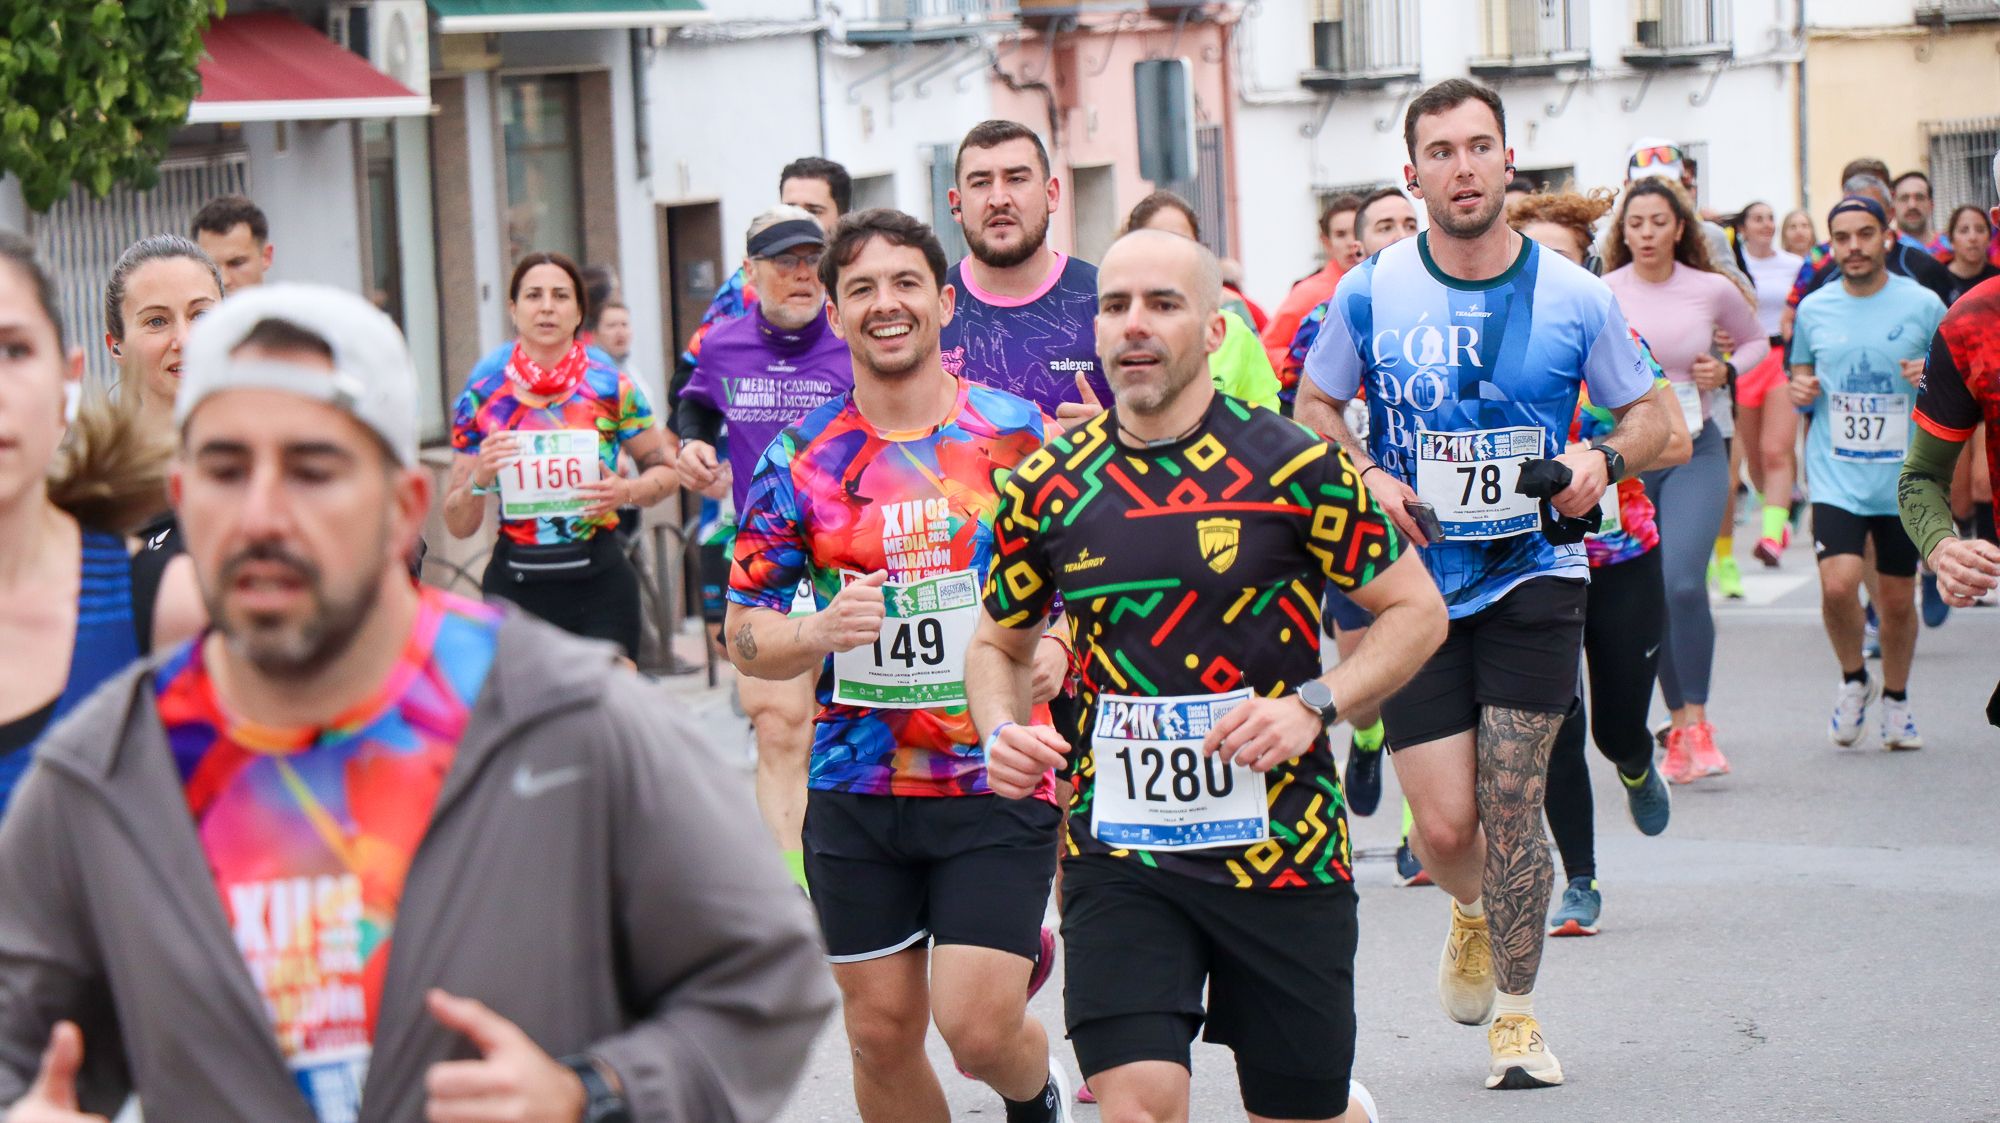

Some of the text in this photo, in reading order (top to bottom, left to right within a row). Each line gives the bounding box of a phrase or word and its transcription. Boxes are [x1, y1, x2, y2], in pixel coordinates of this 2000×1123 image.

[1372, 311, 1483, 368] CÓR
[1060, 357, 1094, 371] alexen
[721, 378, 832, 405] V MEDIA CAMINO
[1845, 415, 1885, 440] 337
[1435, 435, 1474, 462] 21K
[513, 457, 583, 490] 1156
[1457, 464, 1501, 505] 78
[881, 497, 950, 538] XII 08
[883, 533, 928, 555] MEDIA
[928, 530, 951, 543] 2026
[886, 546, 951, 570] MARATÓN
[1064, 556, 1106, 573] TEAMERGY
[873, 617, 945, 668] 149
[1113, 703, 1159, 740] 21K
[1116, 746, 1234, 802] 1280
